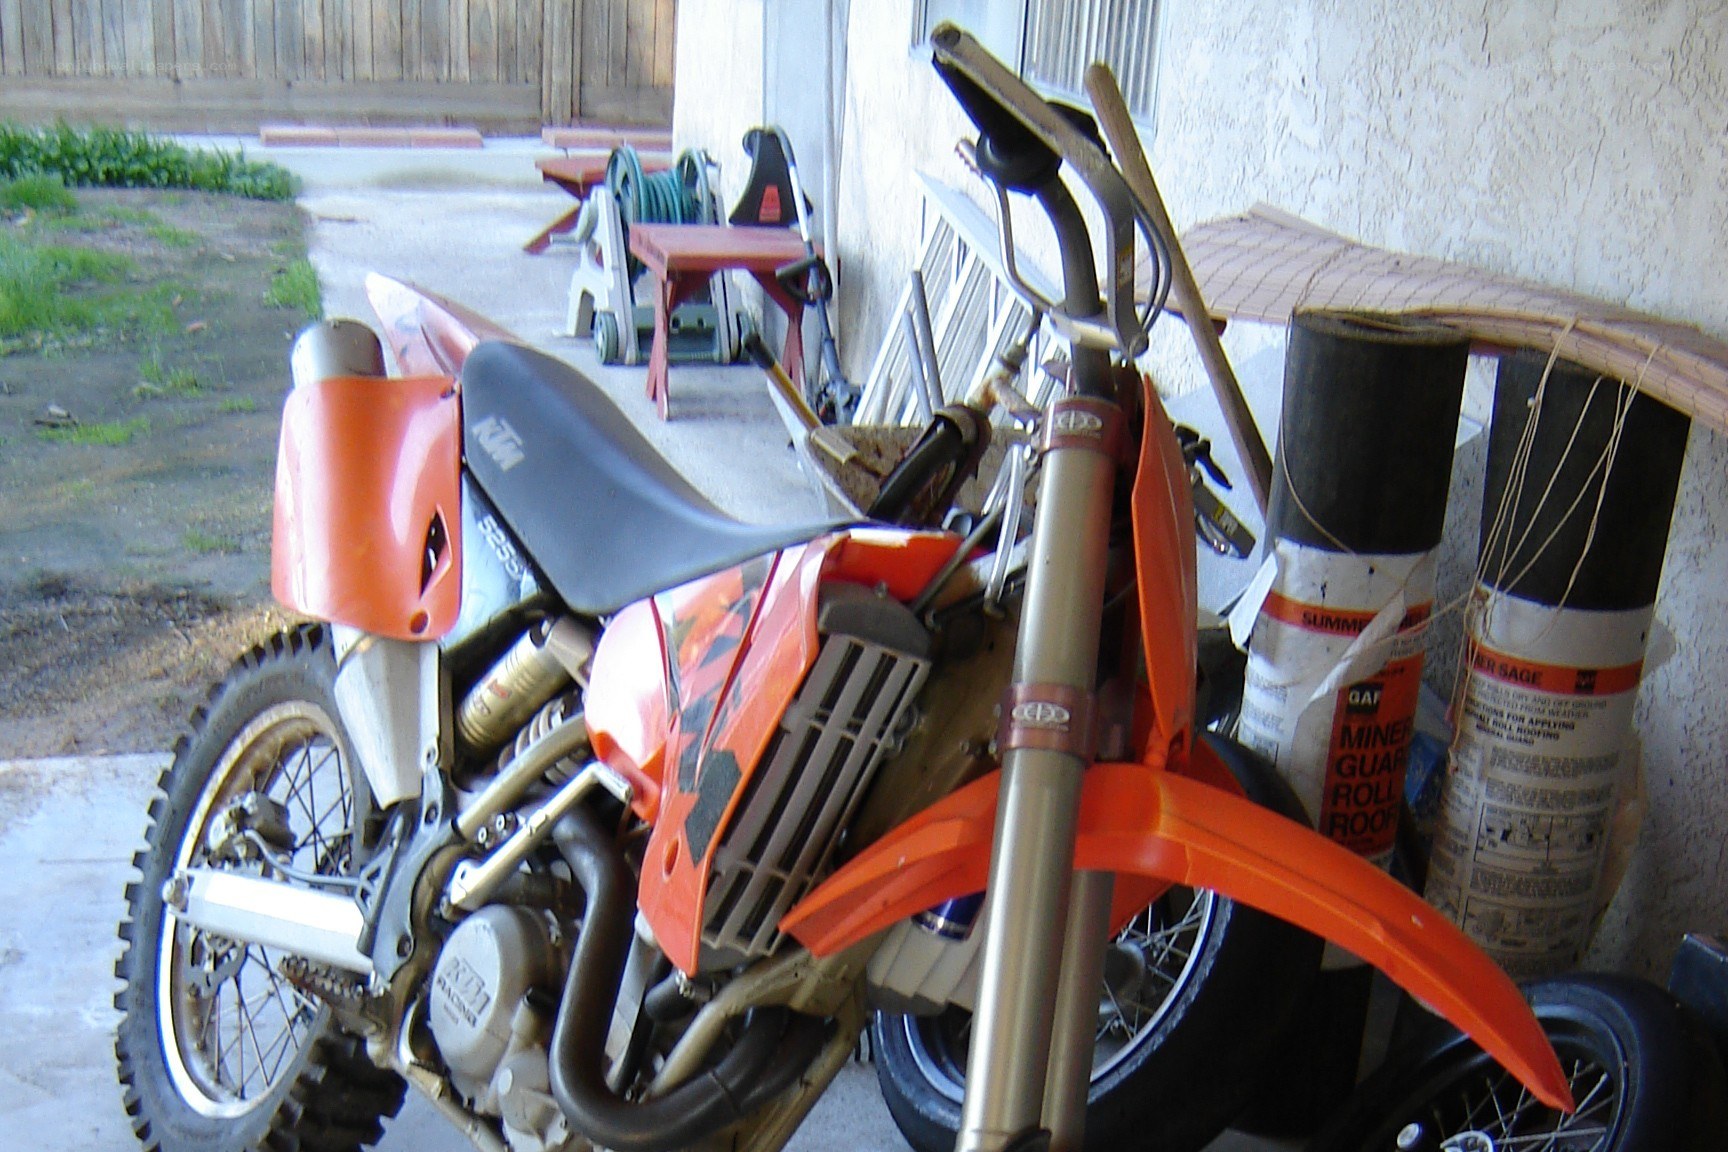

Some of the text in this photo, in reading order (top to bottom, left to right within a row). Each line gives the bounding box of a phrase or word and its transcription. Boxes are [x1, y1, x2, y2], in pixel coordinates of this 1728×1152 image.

[471, 415, 526, 473] KTM
[1499, 663, 1544, 685] SAGE
[1348, 689, 1381, 706] GAF
[1506, 711, 1526, 723] FOR
[1528, 717, 1575, 731] APPLYING
[1516, 725, 1560, 741] ROOFING
[1332, 778, 1396, 808] ROLL
[436, 974, 478, 1029] RACING
